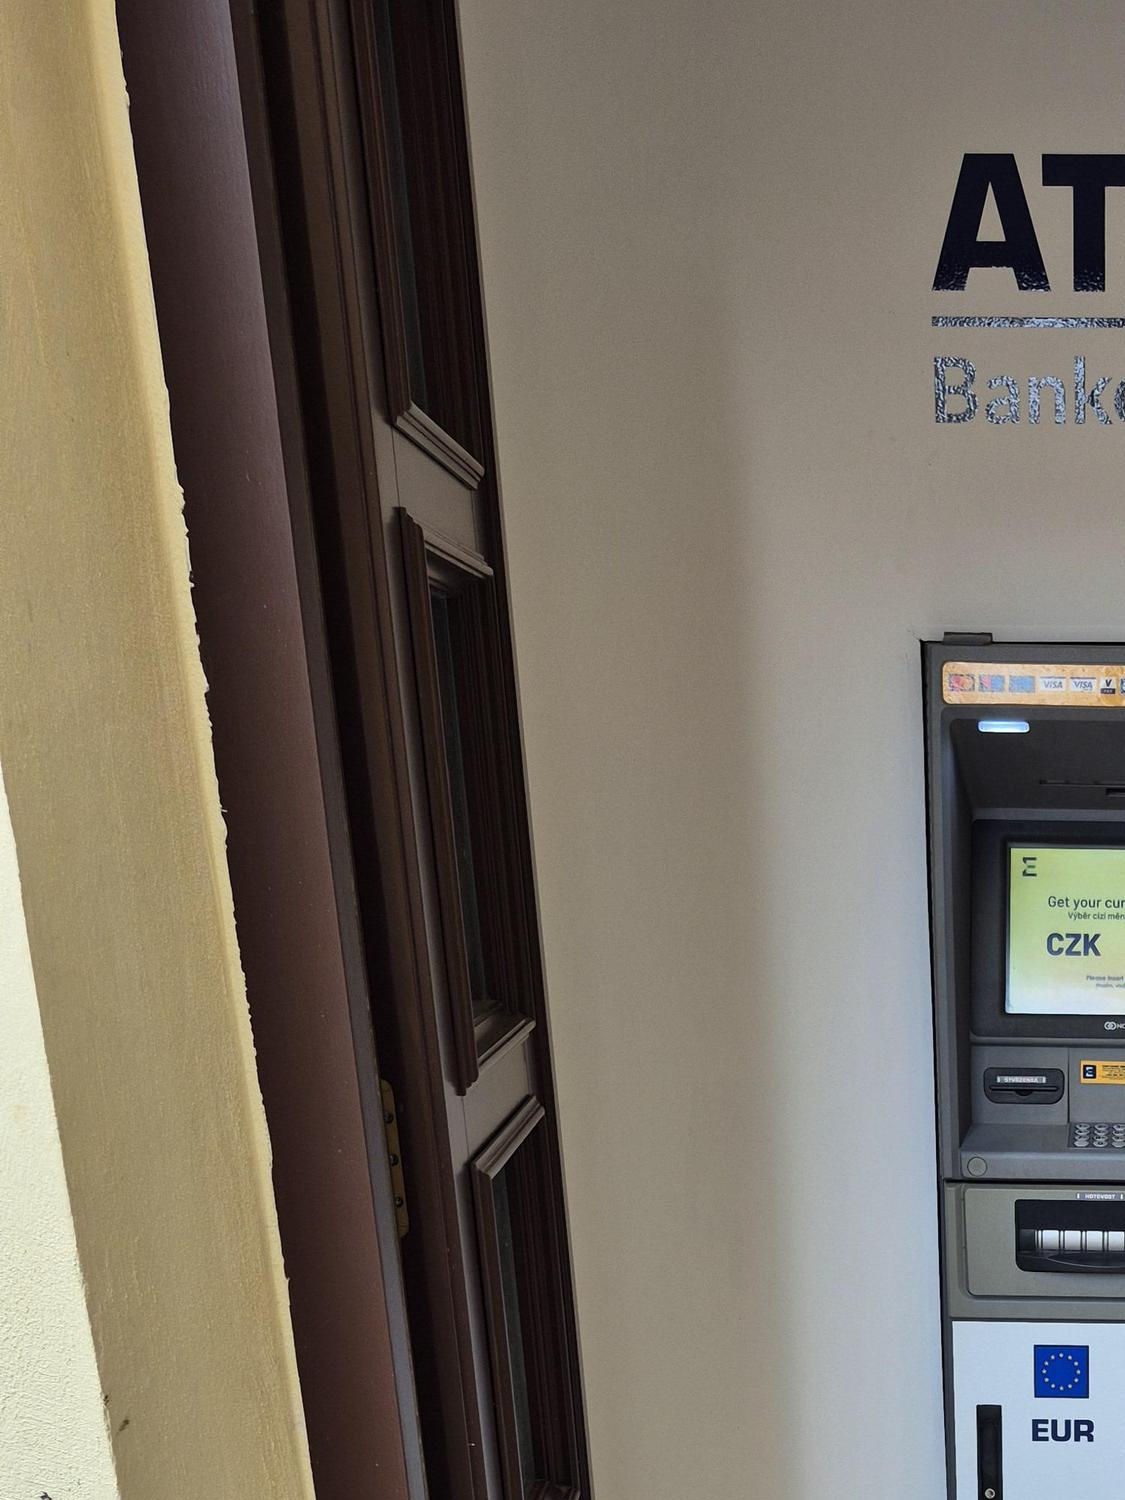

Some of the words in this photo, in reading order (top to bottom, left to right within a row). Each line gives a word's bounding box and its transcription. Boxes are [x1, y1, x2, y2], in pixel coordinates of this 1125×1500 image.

[1048, 895, 1070, 908] Get
[1073, 897, 1102, 911] your
[1067, 911, 1091, 920] Výběr
[1046, 932, 1102, 957] CZK
[1031, 1419, 1094, 1442] EUR
